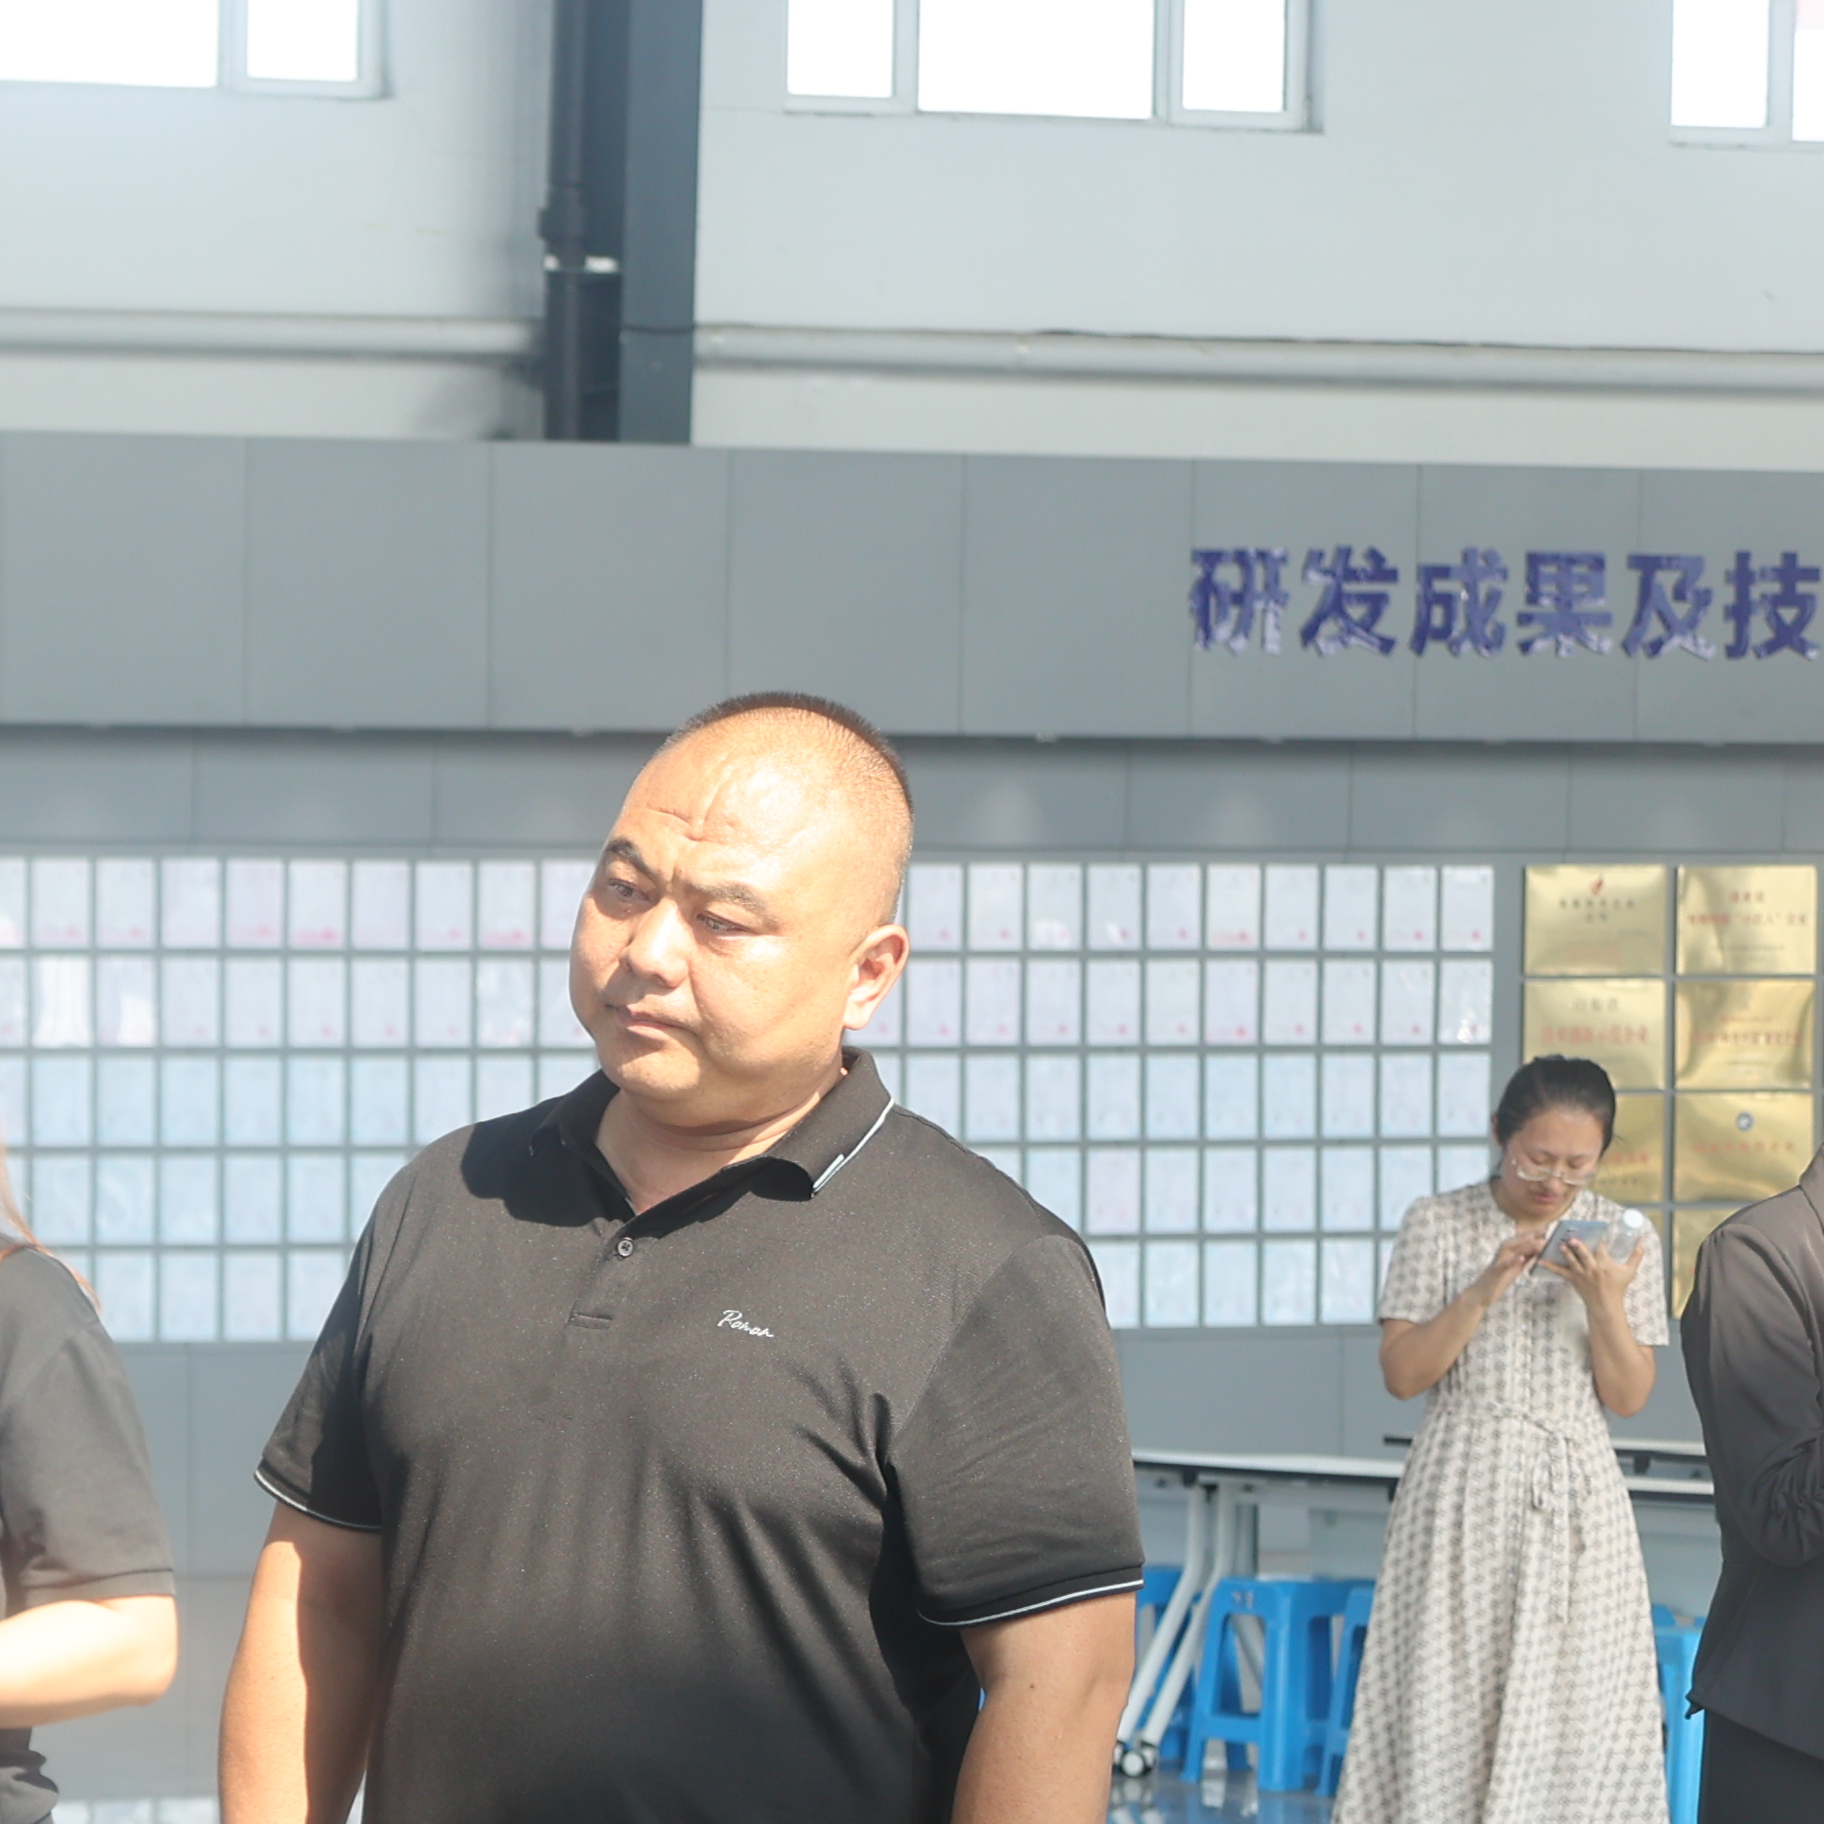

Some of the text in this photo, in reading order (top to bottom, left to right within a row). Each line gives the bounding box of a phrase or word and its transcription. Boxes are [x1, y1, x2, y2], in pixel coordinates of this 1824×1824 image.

[1188, 545, 1822, 660] 研发成果及技
